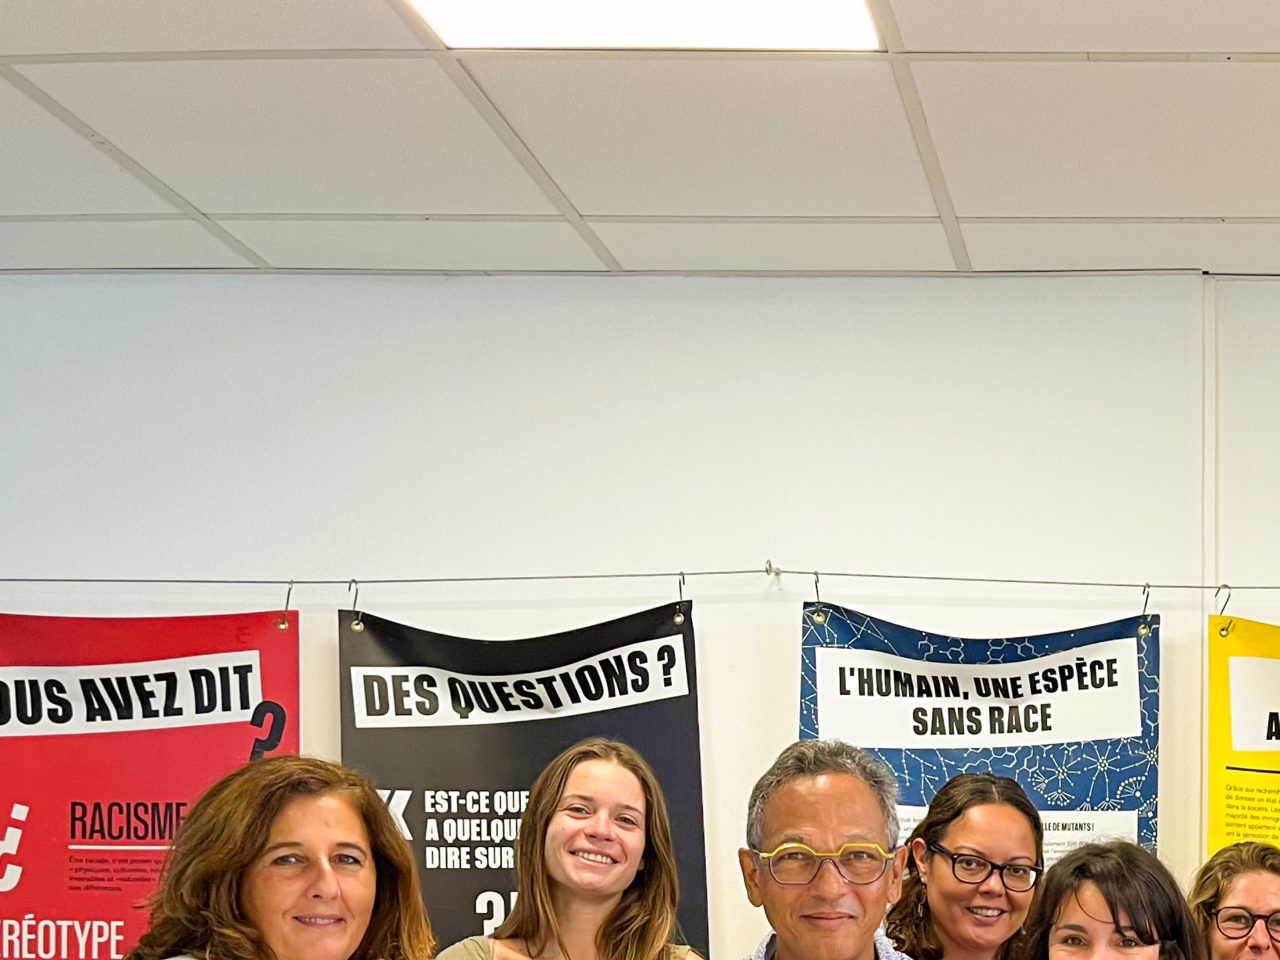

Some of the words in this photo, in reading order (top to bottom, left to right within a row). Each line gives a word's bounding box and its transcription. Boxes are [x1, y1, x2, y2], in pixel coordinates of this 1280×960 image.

[79, 671, 183, 723] AVEZ
[189, 664, 253, 715] DIT
[362, 673, 440, 717] DES
[446, 650, 651, 719] QUESTIONS
[657, 644, 677, 687] ?
[838, 666, 969, 700] L'HUMAIN,
[974, 677, 1024, 699] UNE
[1029, 657, 1119, 697] ESPÈCE
[912, 707, 983, 736] SANS
[988, 703, 1053, 735] RACE
[424, 790, 490, 813] EST-CE
[70, 801, 187, 840] RACISME
[425, 818, 439, 841] A
[1061, 822, 1091, 831] MUTANTS
[425, 846, 471, 869] DIRE
[474, 846, 514, 869] SUR
[0, 913, 124, 960] RÉOTYPE
